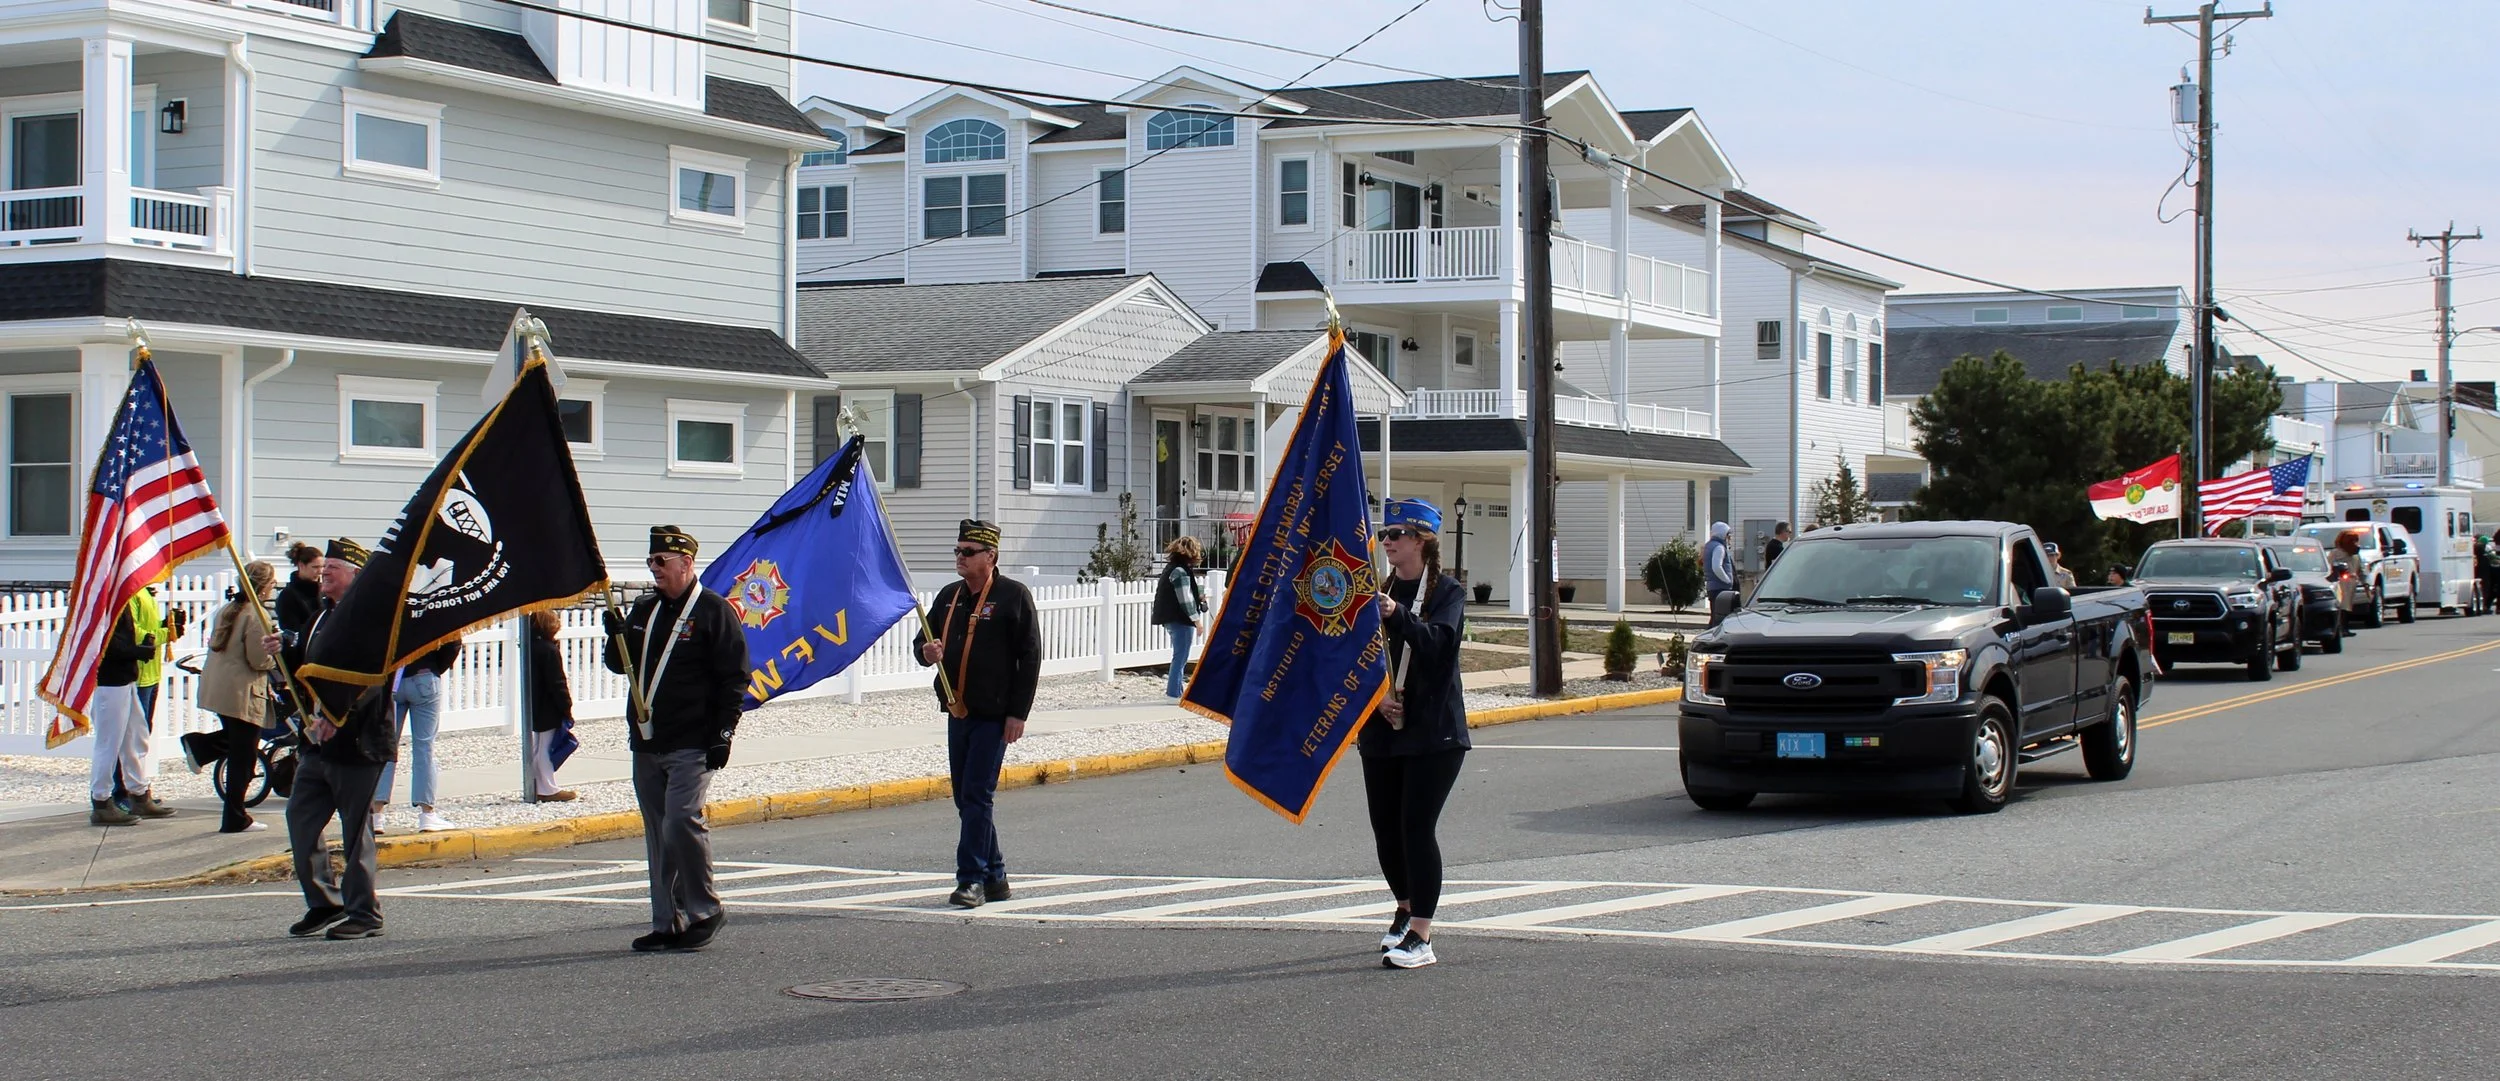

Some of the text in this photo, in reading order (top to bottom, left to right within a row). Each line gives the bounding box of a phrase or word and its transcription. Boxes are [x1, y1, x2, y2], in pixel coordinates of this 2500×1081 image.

[1314, 440, 1347, 498] JERSEY
[833, 480, 851, 506] MIA
[1330, 560, 1347, 573] WARS
[1231, 629, 1254, 656] SEA
[1244, 590, 1267, 623] ISLE
[1258, 552, 1280, 586] CITY
[1332, 584, 1353, 614] AUXILIARY
[1261, 631, 1304, 702] INSTITUTED
[1791, 675, 1813, 686] Ford
[1300, 692, 1347, 758] VETERANS
[1343, 670, 1360, 691] OF
[1779, 739, 1815, 752] KIX 1
